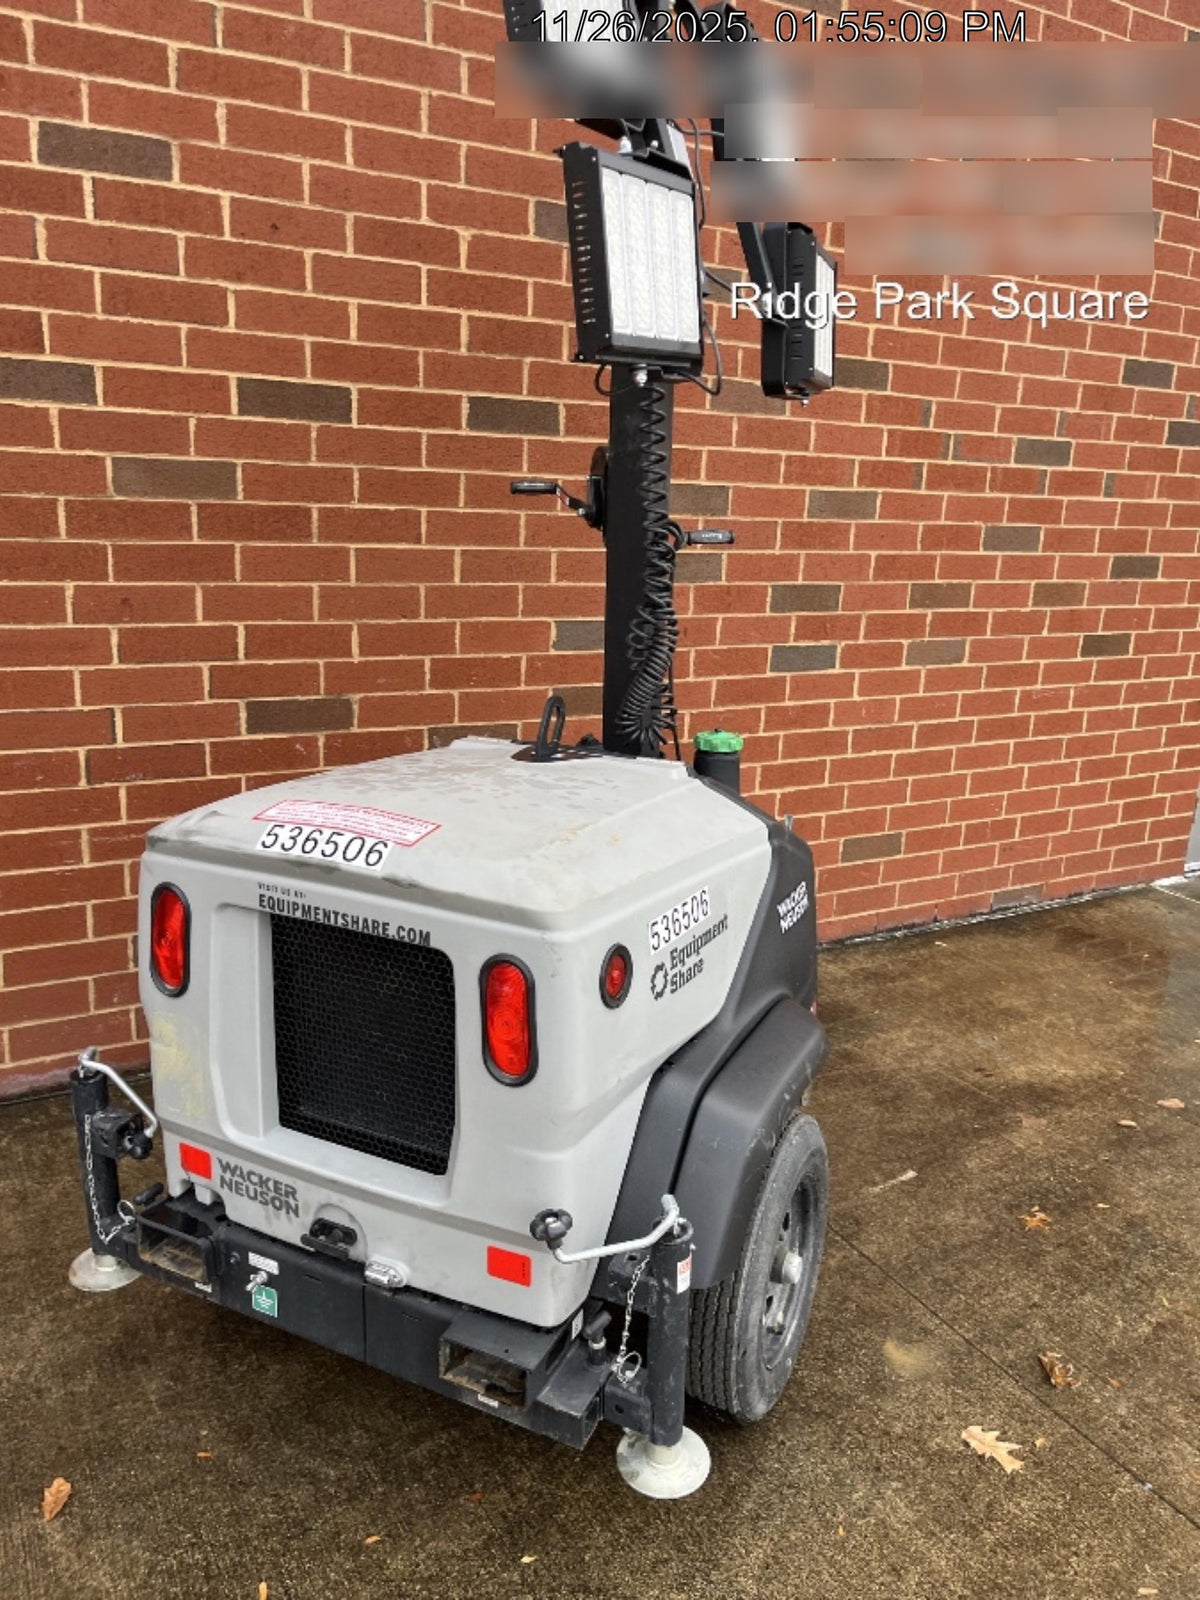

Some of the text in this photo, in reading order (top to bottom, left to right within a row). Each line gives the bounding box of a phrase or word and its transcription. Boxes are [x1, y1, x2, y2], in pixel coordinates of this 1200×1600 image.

[260, 824, 389, 867] 536506
[259, 893, 431, 946] EQUIPMENTSHARE.COM
[650, 891, 709, 951] 536506
[670, 914, 729, 971] Equipment
[670, 958, 705, 994] Share
[217, 1158, 299, 1202] WACKER
[220, 1176, 300, 1218] NEUSON
